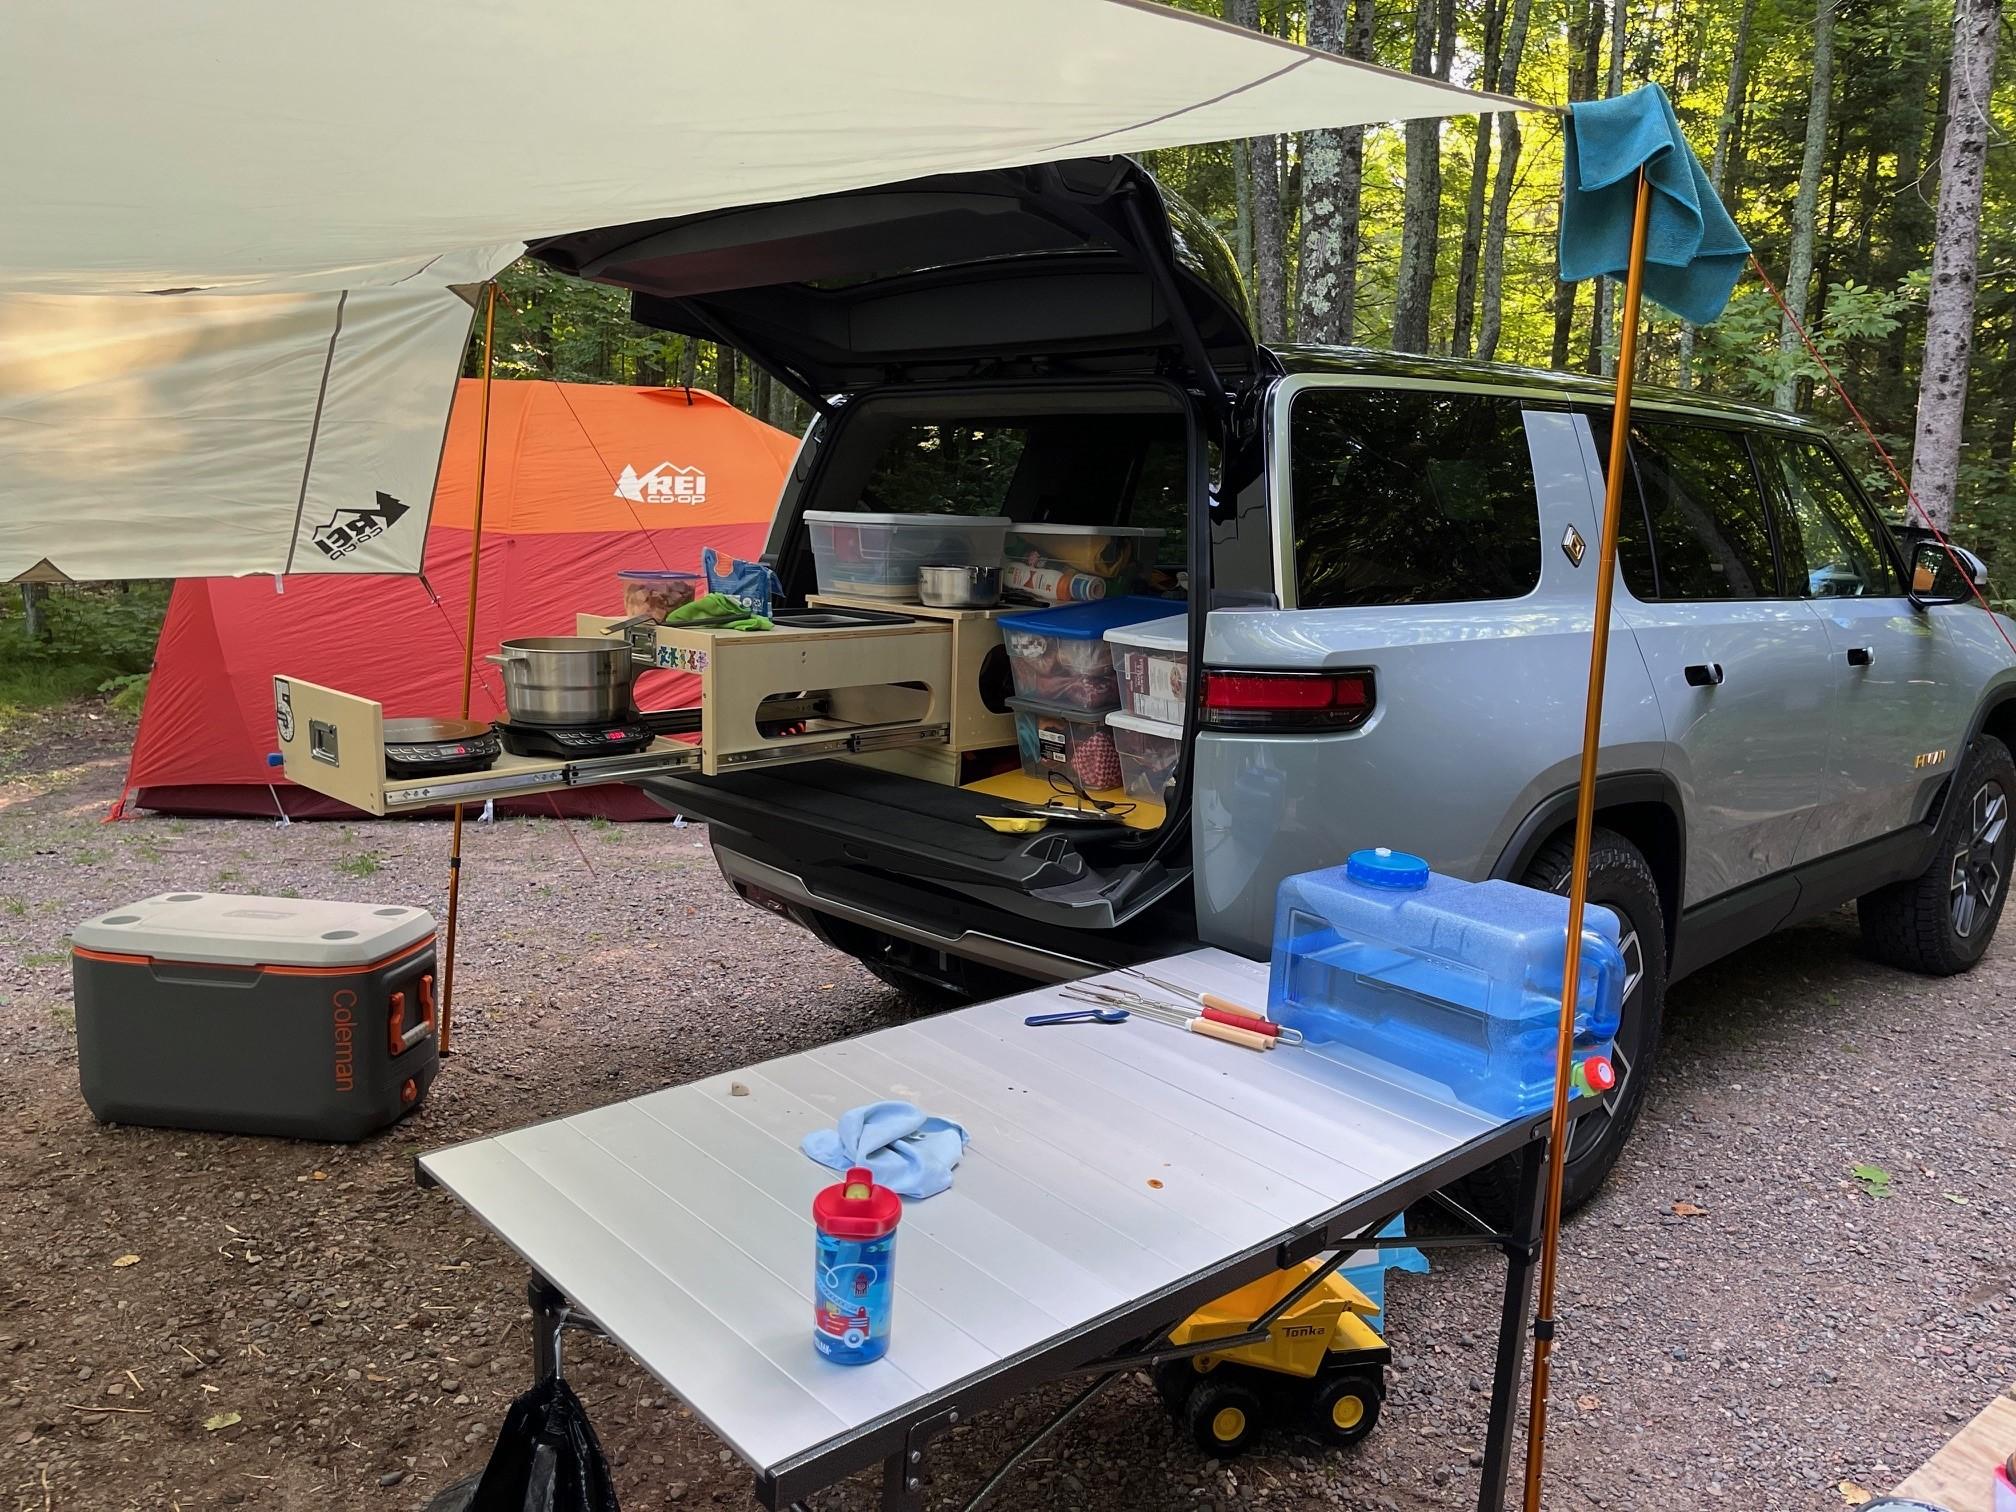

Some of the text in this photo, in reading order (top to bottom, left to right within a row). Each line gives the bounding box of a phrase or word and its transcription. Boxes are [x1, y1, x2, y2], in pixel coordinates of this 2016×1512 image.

[647, 475, 706, 495] REI
[332, 989, 358, 1092] Coleman
[1282, 1325, 1326, 1338] Tonka
